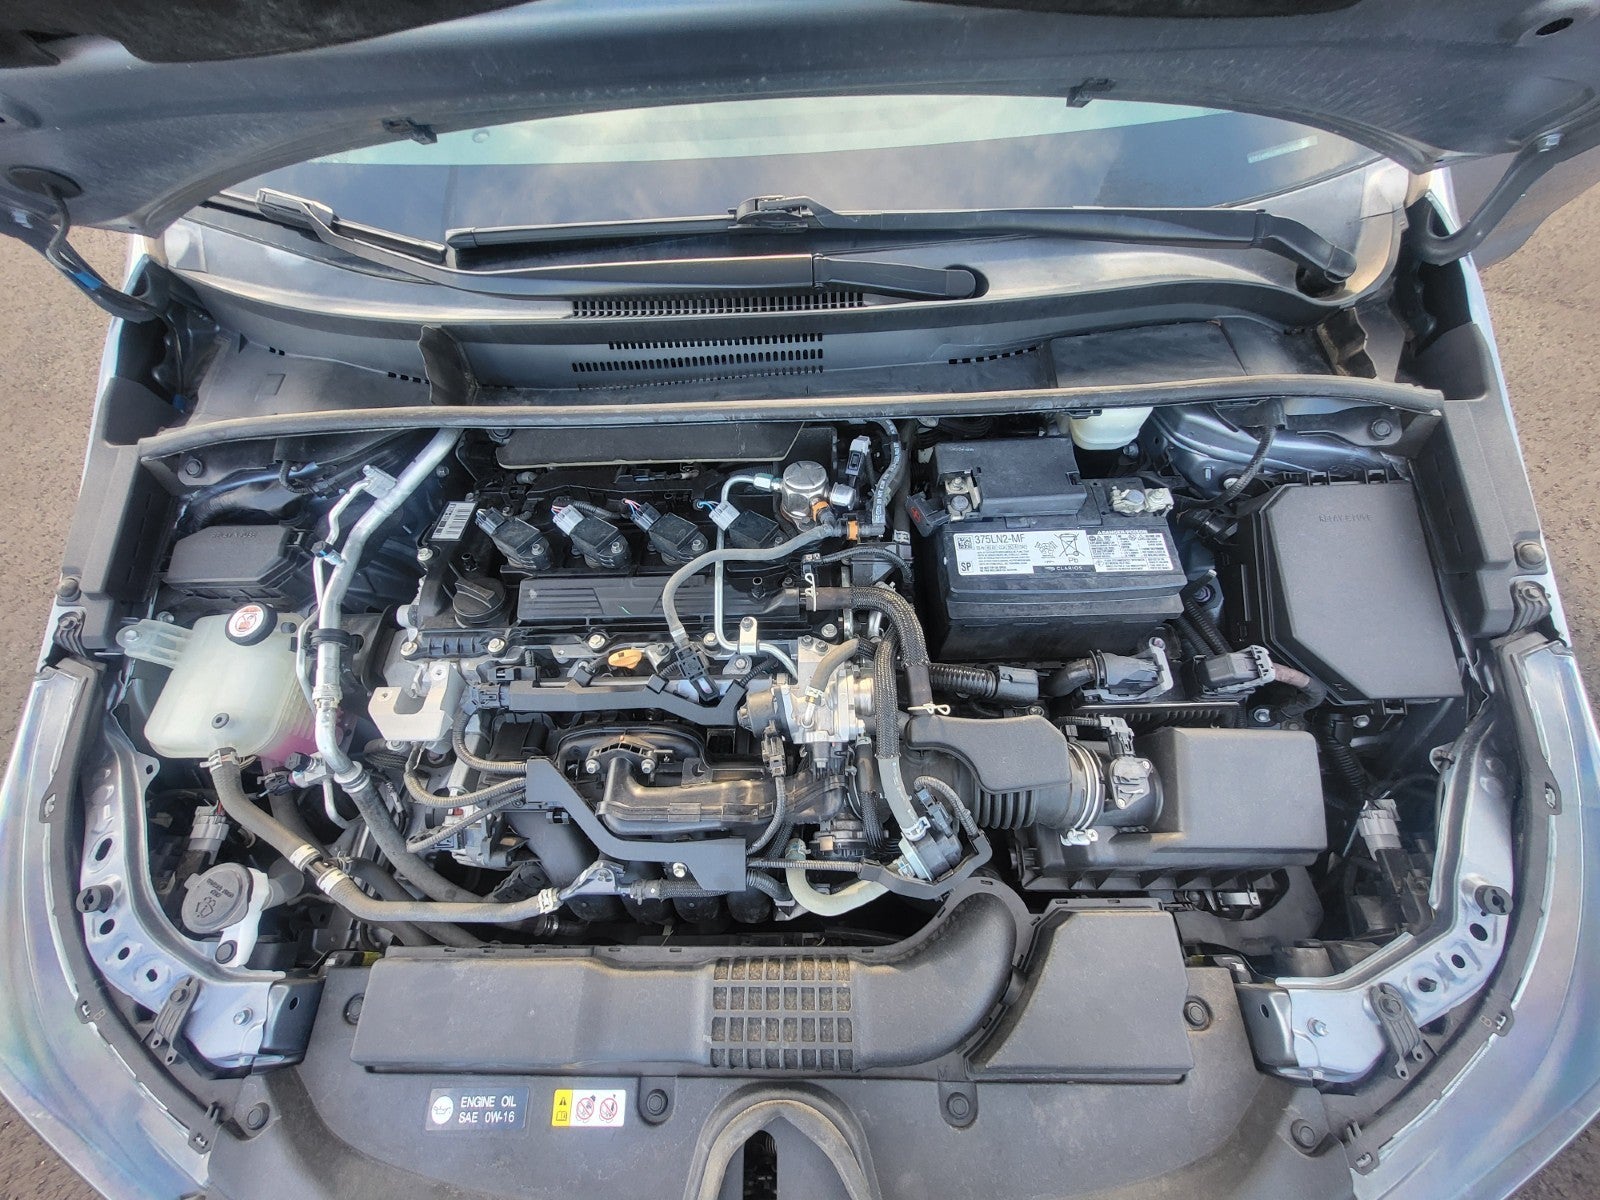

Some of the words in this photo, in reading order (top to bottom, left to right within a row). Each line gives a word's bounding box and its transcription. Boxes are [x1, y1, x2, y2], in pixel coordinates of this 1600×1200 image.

[974, 534, 1025, 544] 375LN2-MF
[961, 562, 972, 573] SP
[460, 1096, 496, 1107] ENGINE
[501, 1096, 517, 1107] OIL
[458, 1112, 478, 1123] SAE
[485, 1111, 515, 1123] 0W-16
